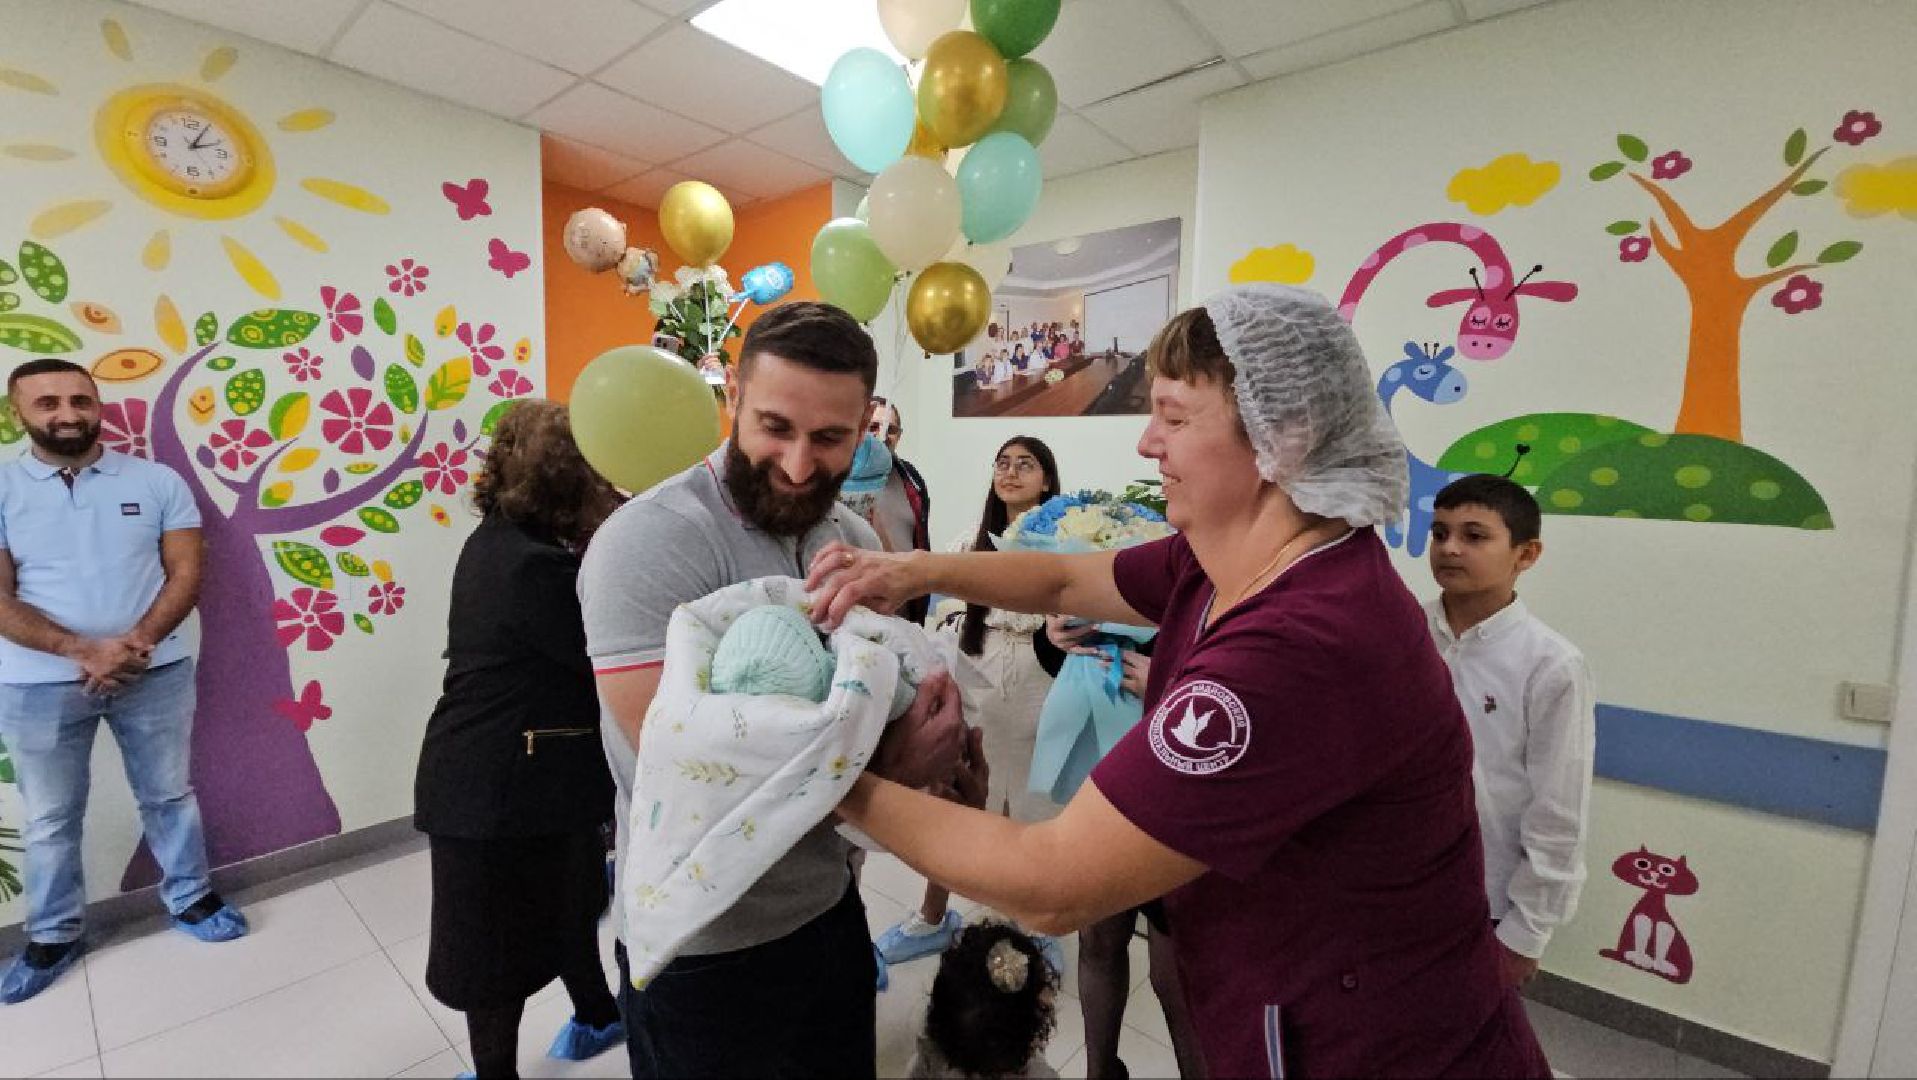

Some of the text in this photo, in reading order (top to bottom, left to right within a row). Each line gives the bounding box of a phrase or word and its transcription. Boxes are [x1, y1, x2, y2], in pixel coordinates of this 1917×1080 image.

[181, 117, 200, 130] 12
[154, 135, 168, 147] 9
[215, 148, 228, 159] 3
[186, 166, 200, 177] 6
